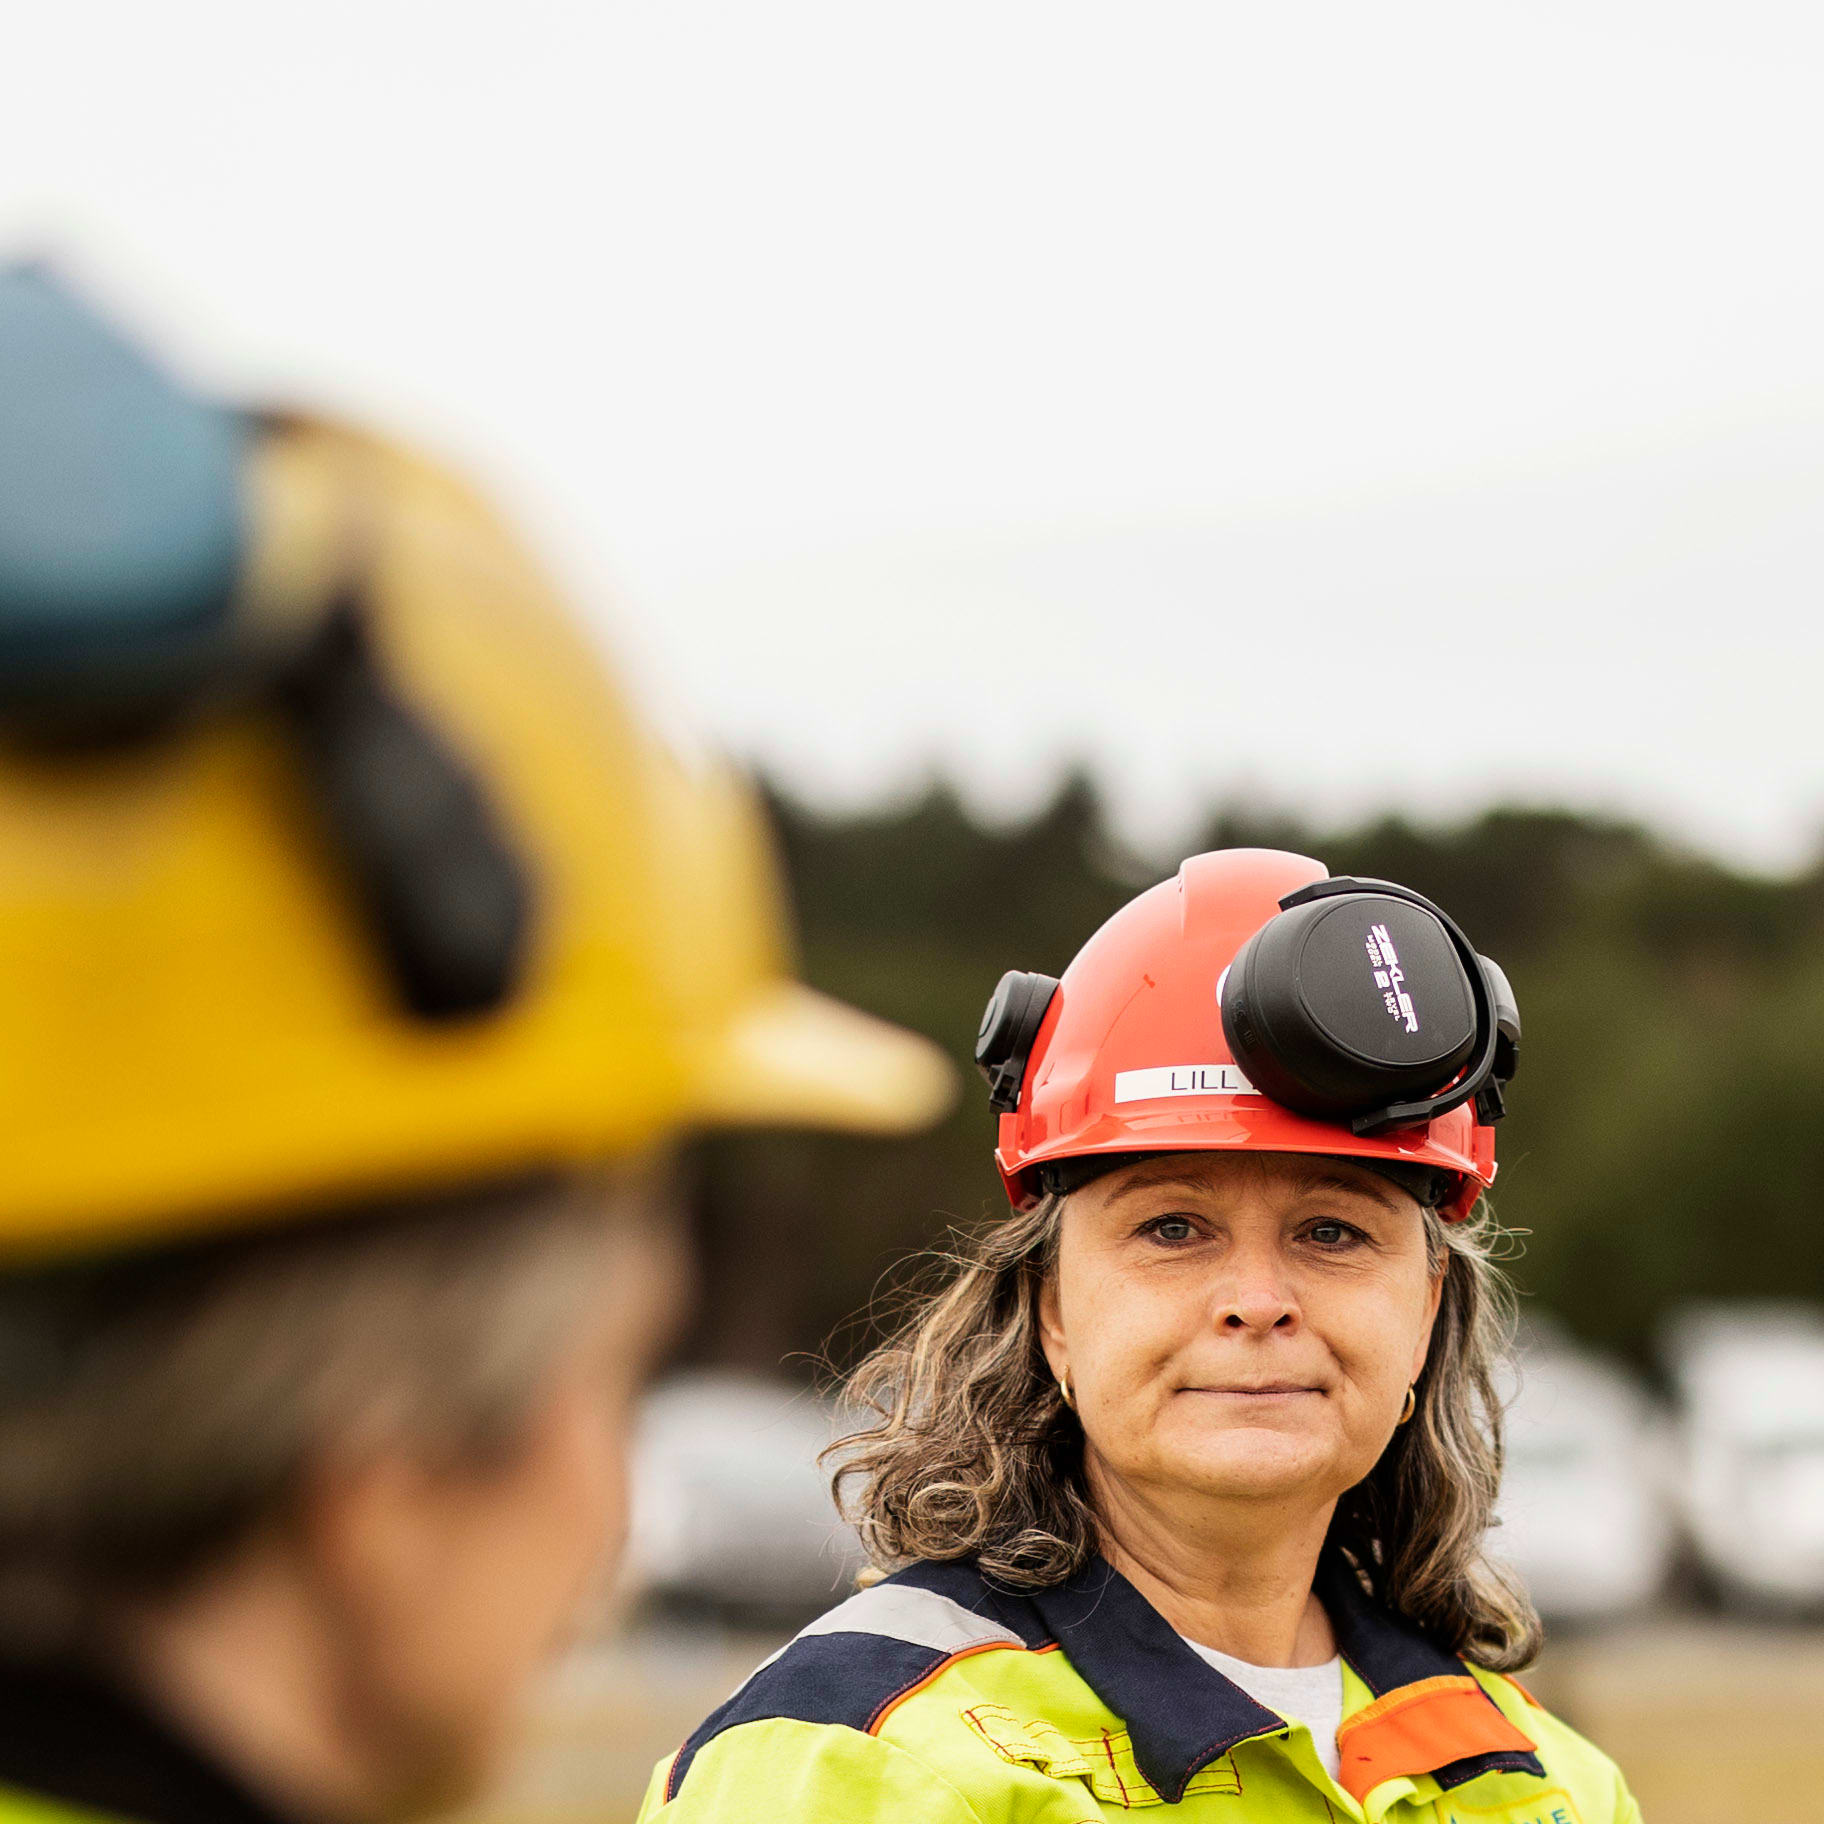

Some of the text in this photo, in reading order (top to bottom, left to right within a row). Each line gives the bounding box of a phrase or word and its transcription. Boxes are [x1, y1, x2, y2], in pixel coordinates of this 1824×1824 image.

[1371, 924, 1419, 1034] ZEKLER
[1373, 970, 1391, 989] 2
[1171, 1070, 1238, 1091] LILL
